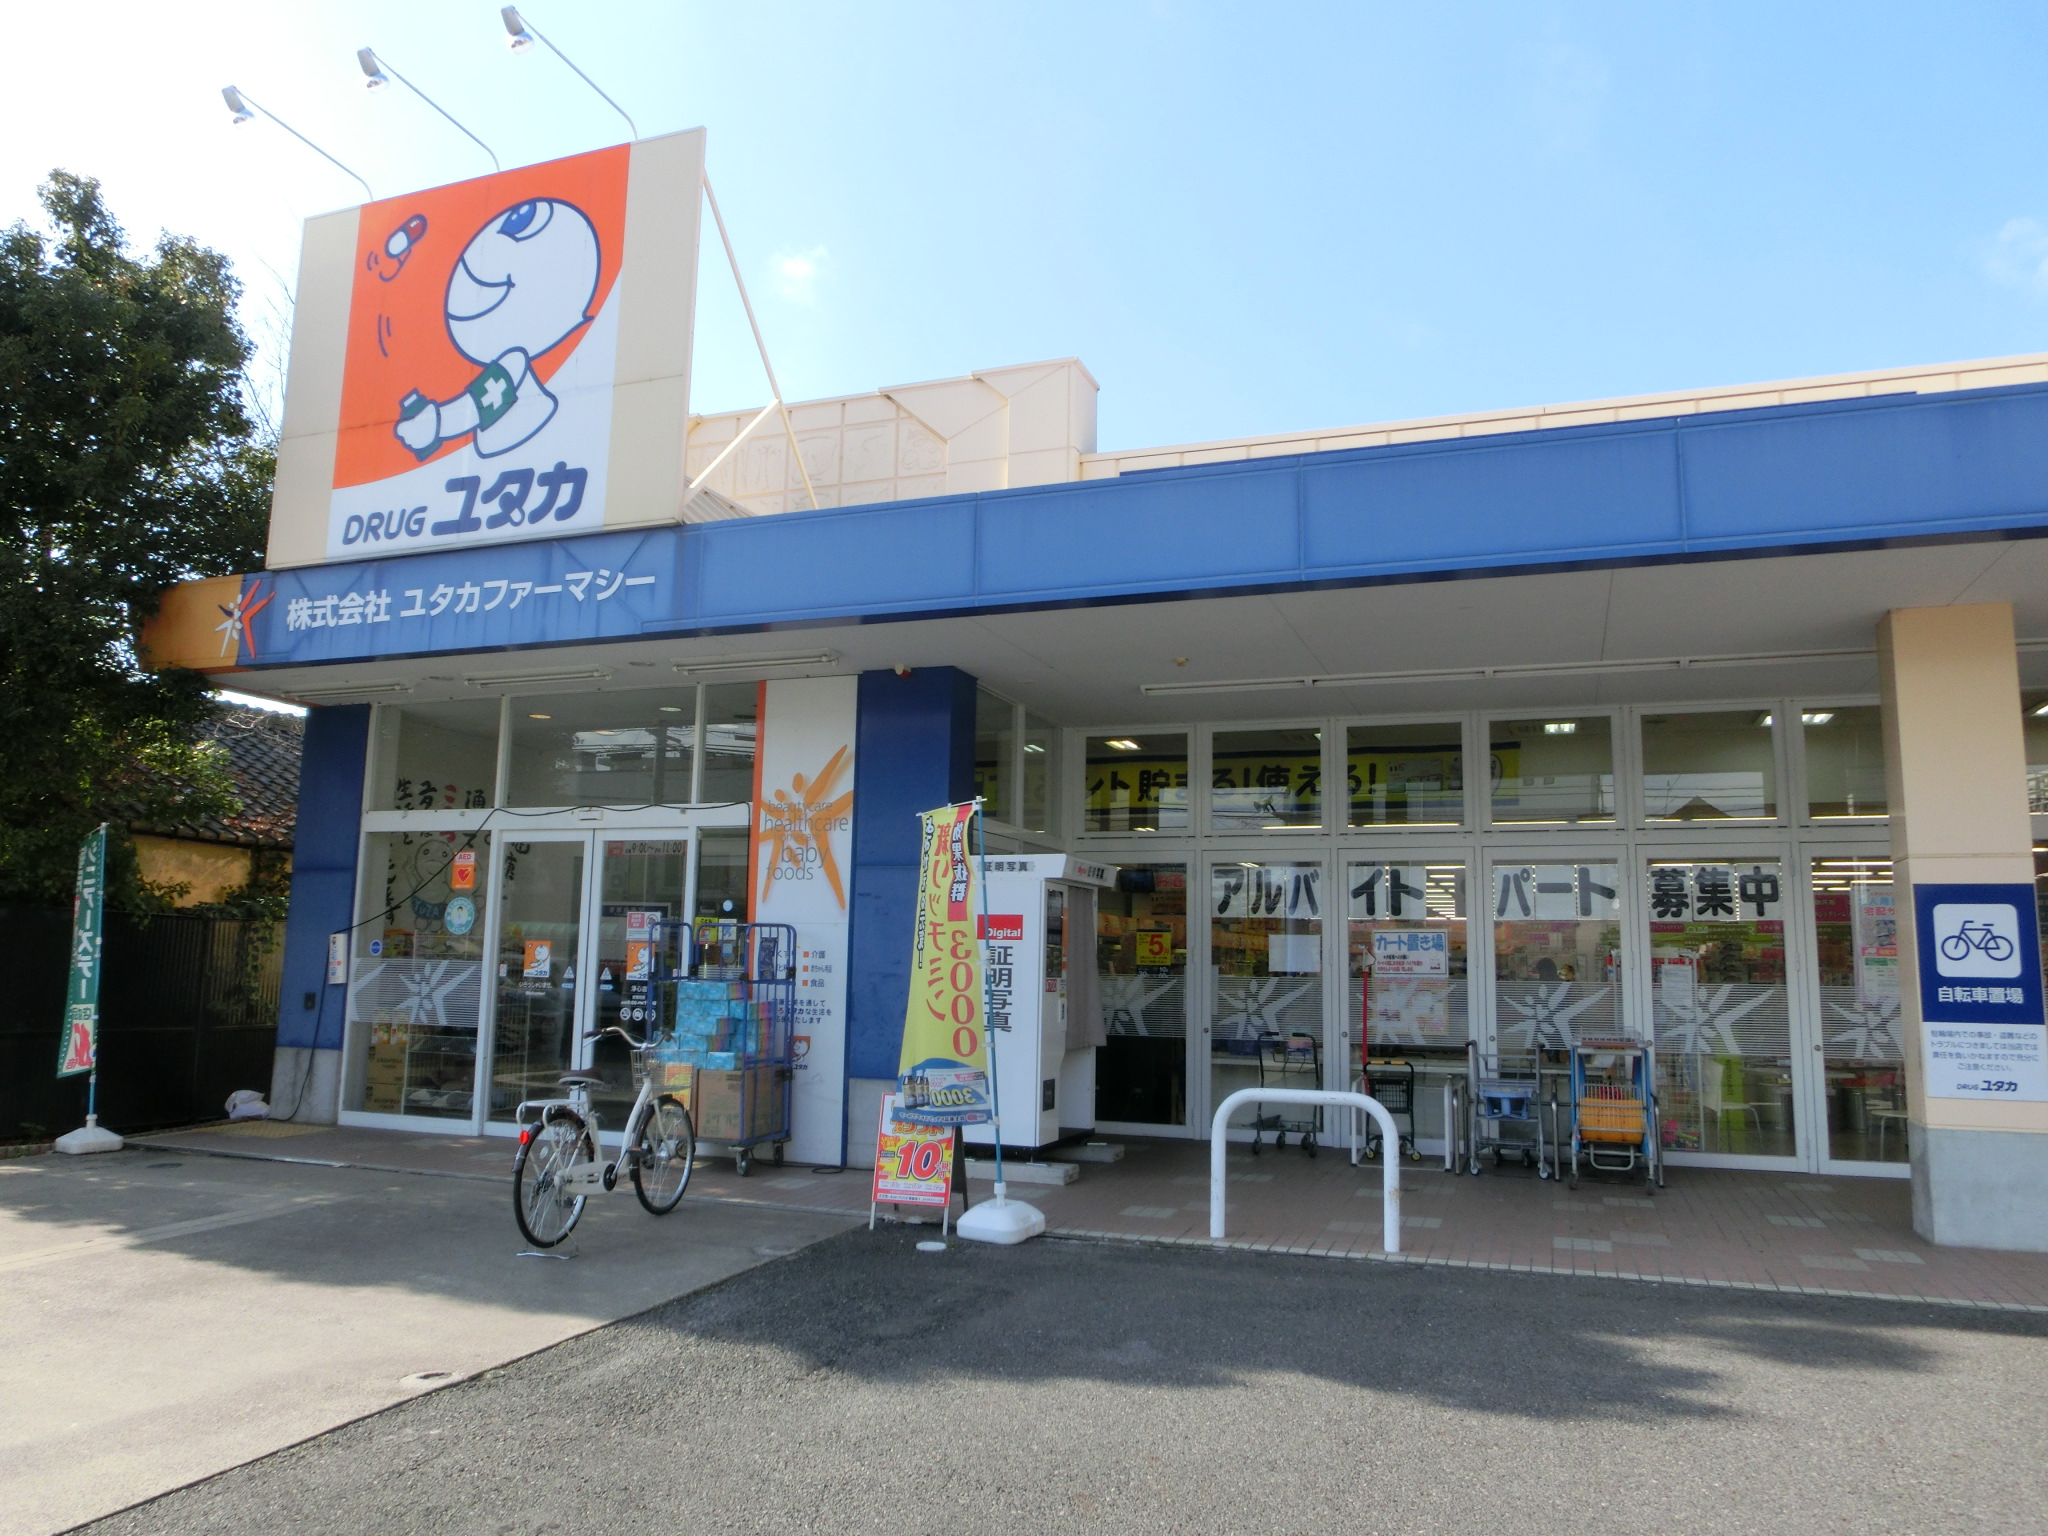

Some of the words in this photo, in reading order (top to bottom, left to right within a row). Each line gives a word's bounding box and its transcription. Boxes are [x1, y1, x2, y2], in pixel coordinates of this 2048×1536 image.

[342, 504, 428, 545] DRUG
[431, 461, 589, 537] ユタカ
[286, 589, 392, 633] 株式会社
[399, 567, 657, 619] ユタカファーマシー
[768, 799, 833, 813] beautycare
[764, 812, 849, 832] healthcare
[781, 840, 830, 869] baby
[765, 861, 814, 881] foods
[983, 860, 1029, 872] 証明写真
[1496, 867, 1616, 917] パート
[1651, 866, 1780, 919] 募集中
[987, 928, 1022, 939] Digital
[1375, 933, 1445, 952] カート置き場
[1148, 933, 1164, 956] 5
[811, 950, 826, 959] 介護
[810, 979, 825, 988] 食品
[984, 945, 1014, 1033] 証明写真
[1937, 986, 2024, 1004] 自転車置場
[1930, 1041, 2038, 1051] トラブルにつきましては当店では
[1980, 1080, 2018, 1092] ユタカ
[897, 1140, 943, 1181] 10
